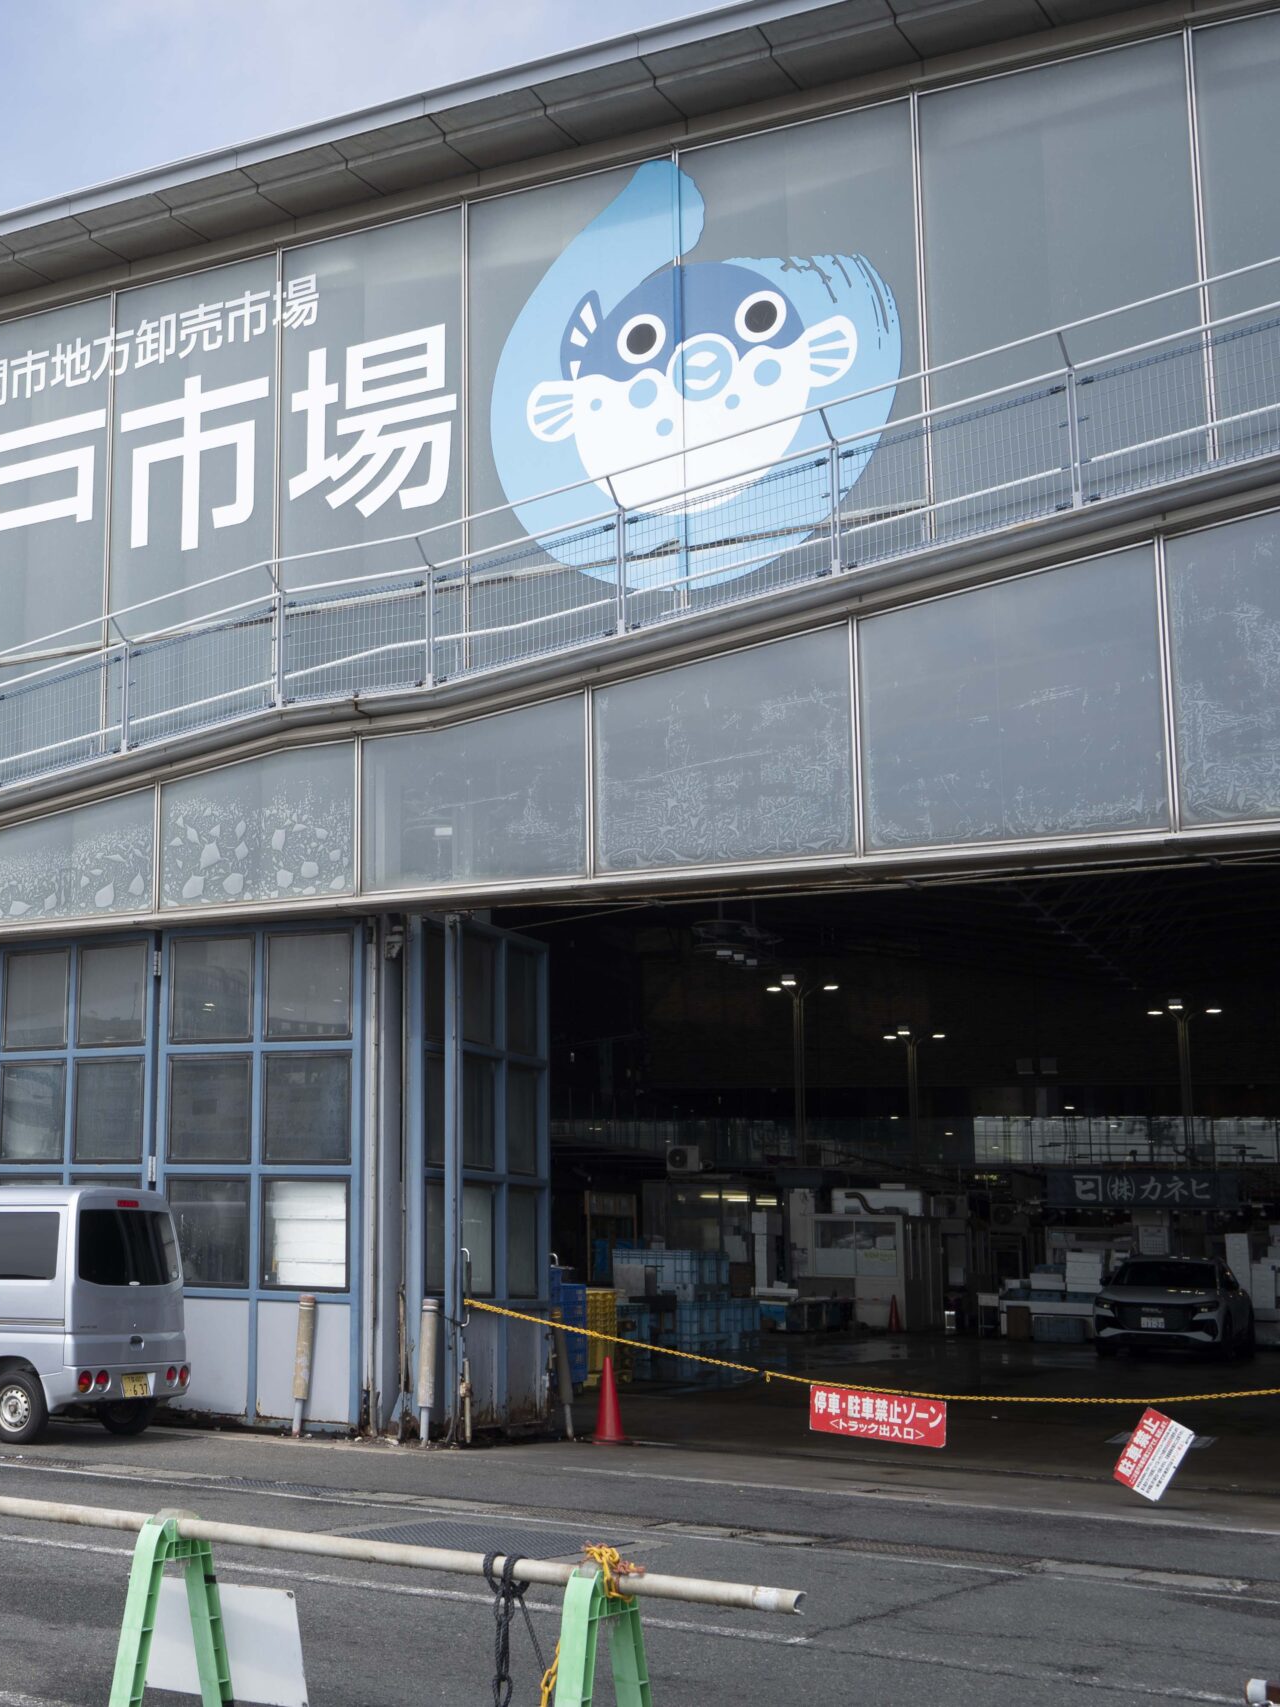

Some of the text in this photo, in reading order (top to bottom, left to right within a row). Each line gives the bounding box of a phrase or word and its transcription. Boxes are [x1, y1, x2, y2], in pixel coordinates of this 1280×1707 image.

[814, 1391, 943, 1428] 停車・駐車禁止ゾーン
[1117, 1417, 1160, 1477] 駐車禁止
